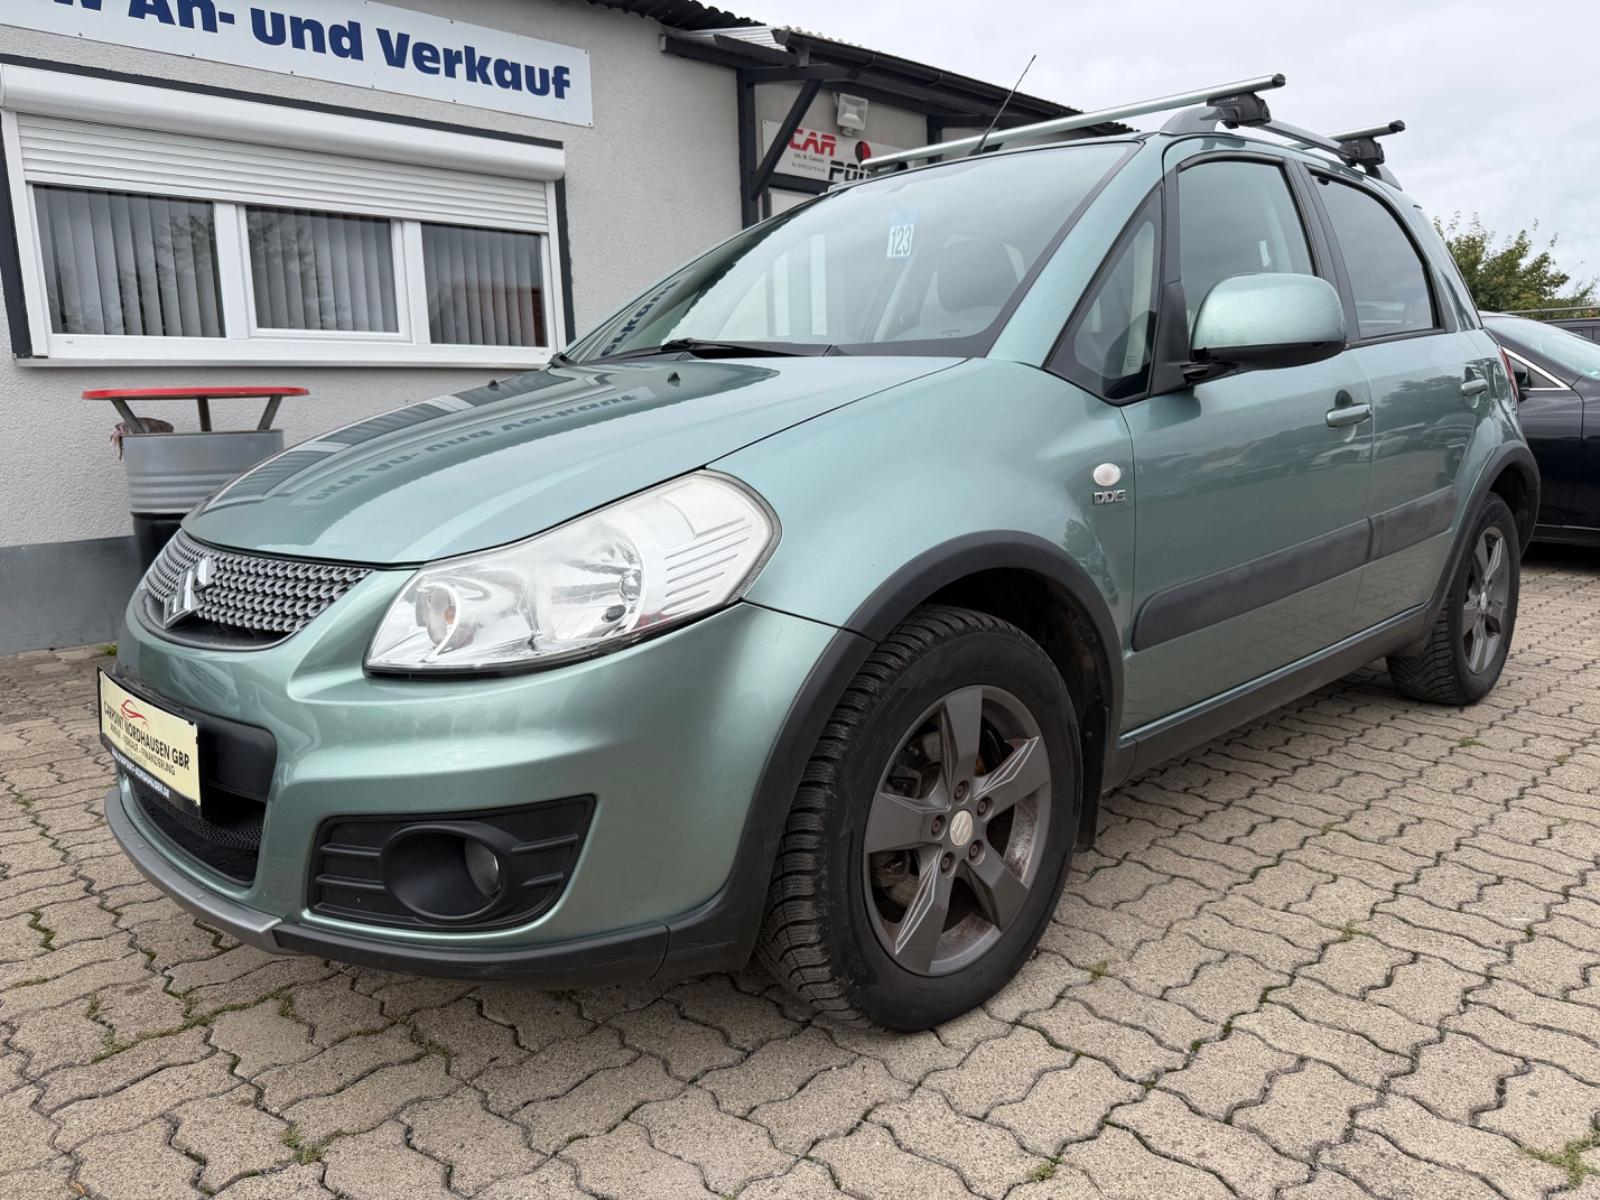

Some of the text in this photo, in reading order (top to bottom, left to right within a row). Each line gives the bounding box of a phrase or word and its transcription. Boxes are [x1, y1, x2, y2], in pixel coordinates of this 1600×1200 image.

[250, 8, 363, 61] und
[376, 28, 571, 99] Verkauf
[789, 128, 836, 157] CAR
[891, 226, 912, 255] 123
[125, 720, 171, 759] NORDHAUSEN
[172, 748, 190, 770] GBR
